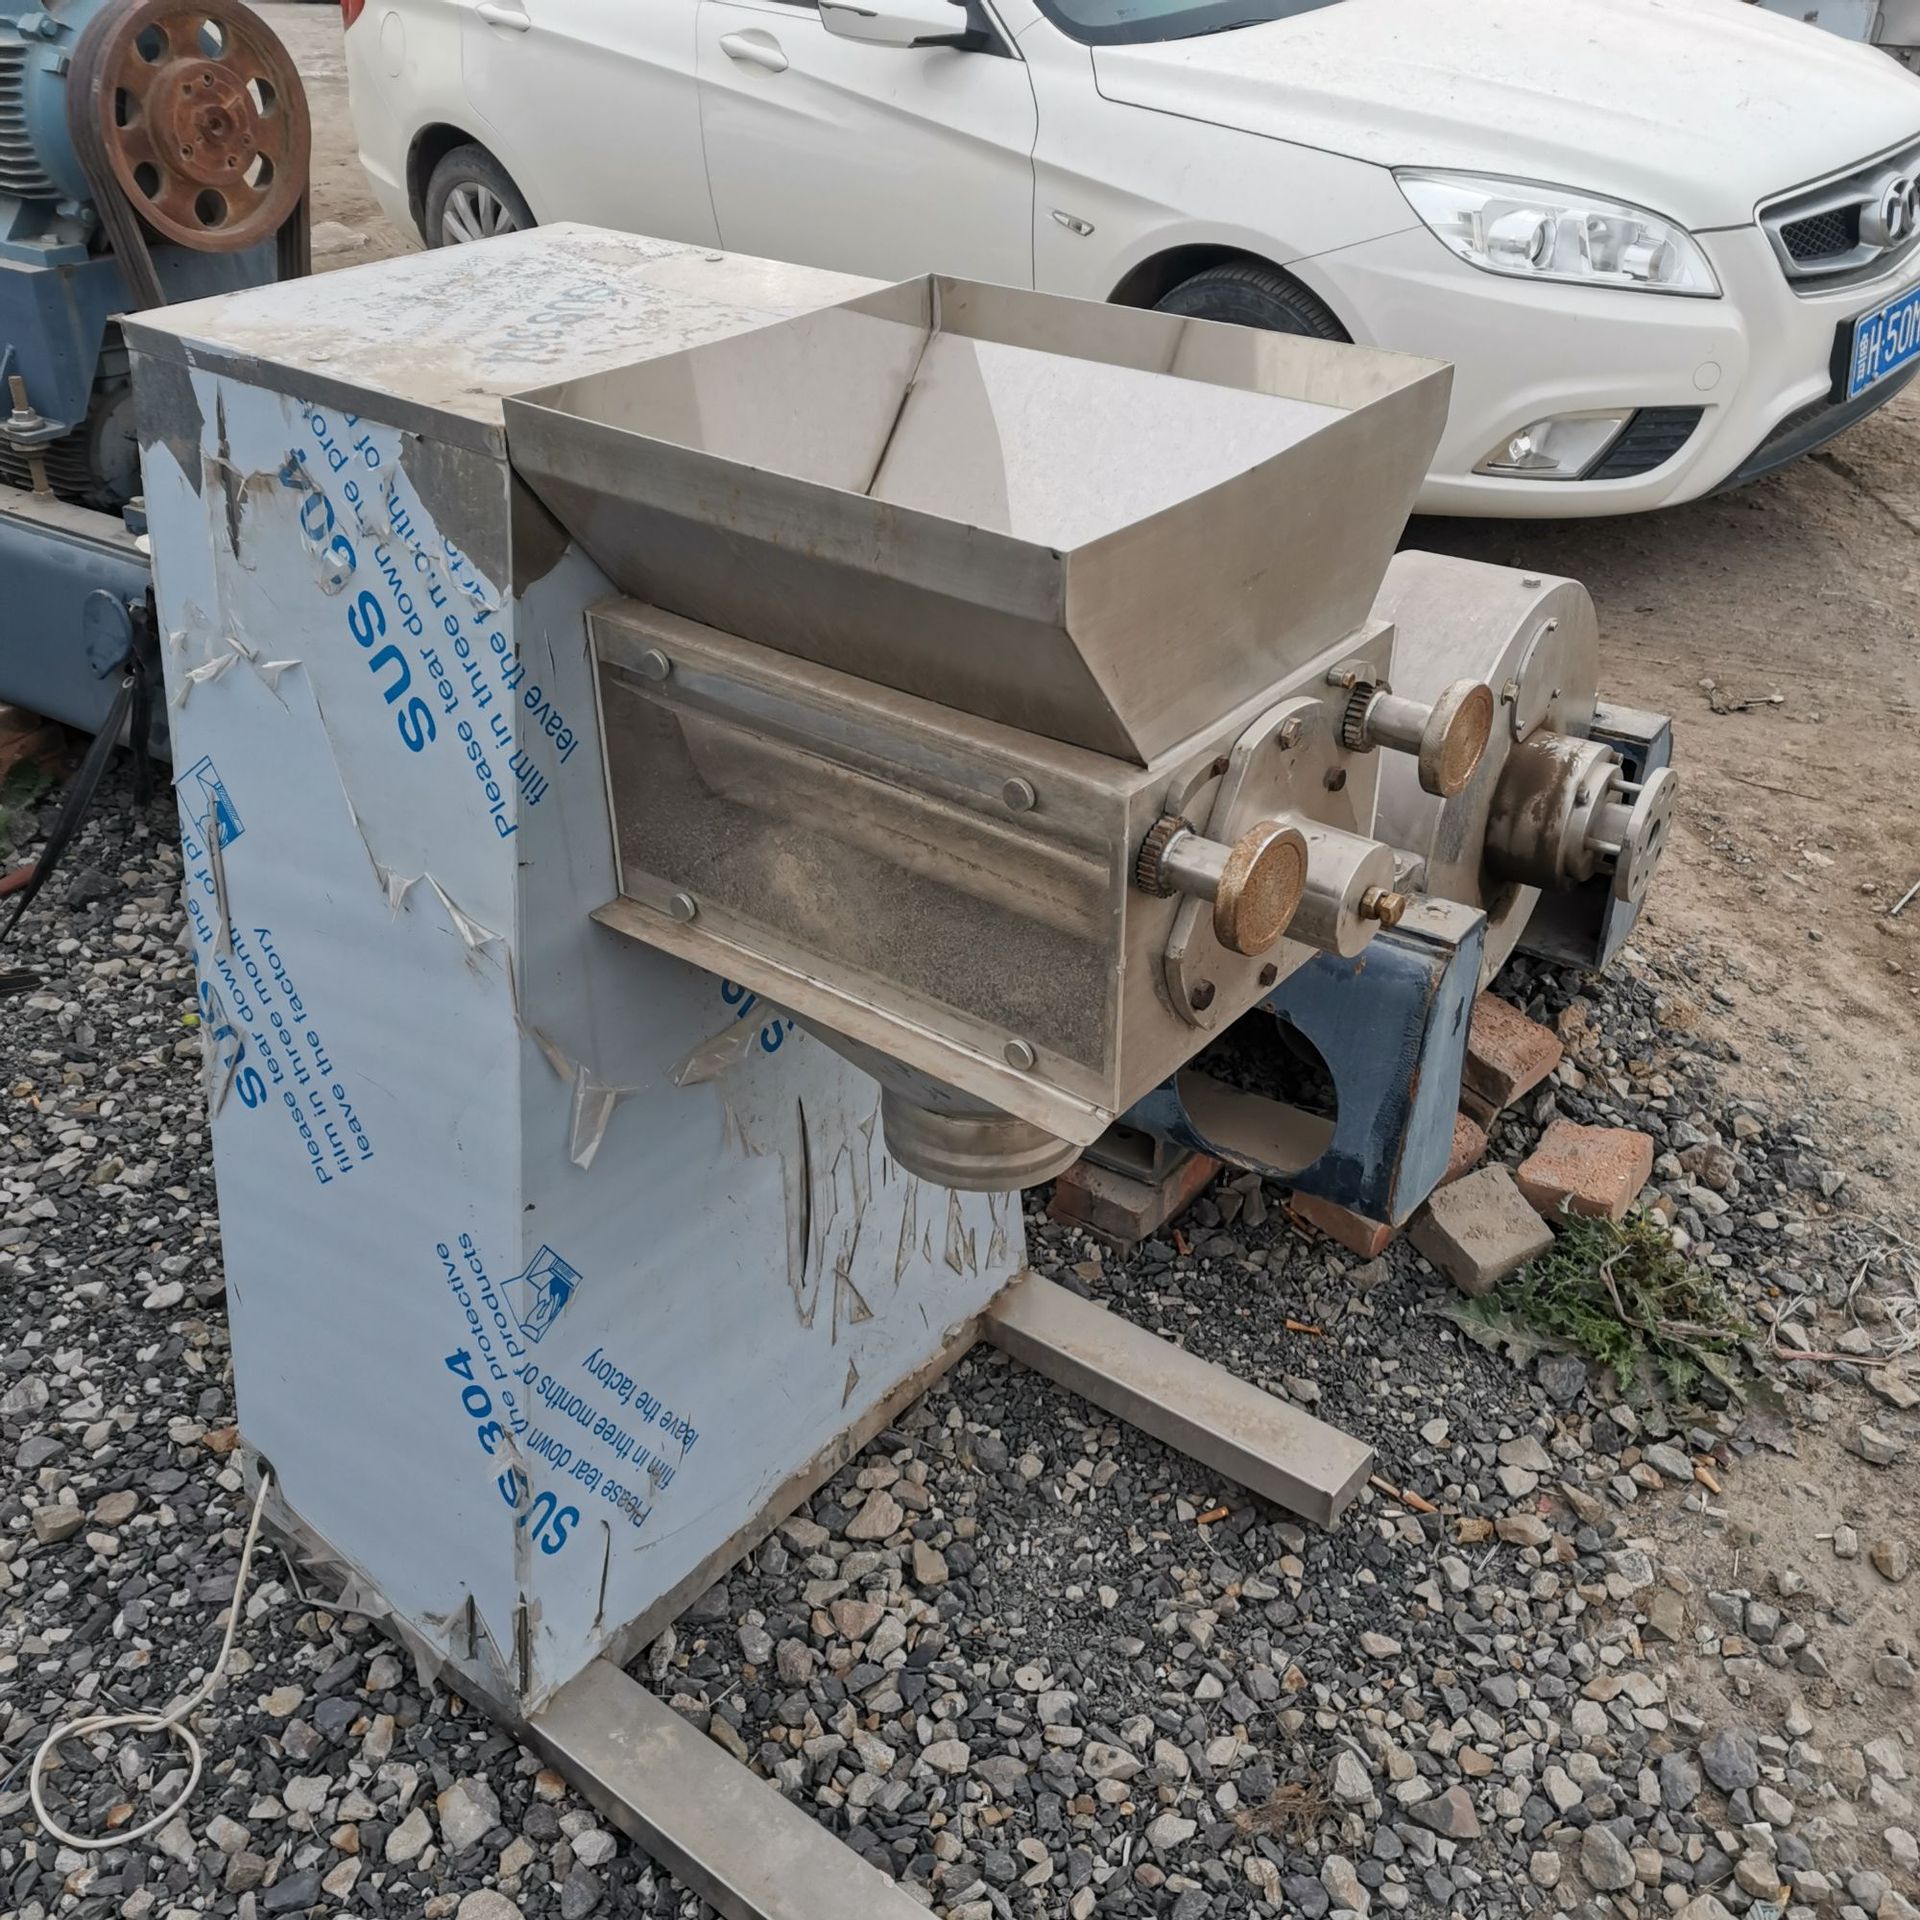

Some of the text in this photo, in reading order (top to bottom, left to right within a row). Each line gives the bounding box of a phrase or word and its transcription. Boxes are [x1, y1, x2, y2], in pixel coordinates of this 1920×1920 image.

[352, 434, 381, 469] of
[373, 542, 424, 637] down
[345, 587, 439, 754] SUS
[419, 647, 460, 715] tear
[443, 613, 494, 710] three
[489, 631, 526, 691] the
[489, 712, 513, 750] in
[523, 685, 580, 765] leave
[457, 720, 520, 839] Please
[508, 748, 550, 807] film
[187, 898, 214, 944] the
[194, 868, 219, 896] of
[251, 1032, 285, 1086] tear
[252, 928, 375, 1161] leave the factory
[269, 1010, 311, 1086] three
[282, 1090, 334, 1185] Please
[308, 1090, 327, 1118] in
[323, 1121, 354, 1174] film
[435, 1242, 653, 1529] Please tear down the protective
[442, 1344, 505, 1456] 304
[457, 1232, 677, 1491] film in three months of products
[581, 1347, 700, 1455] leave the factory
